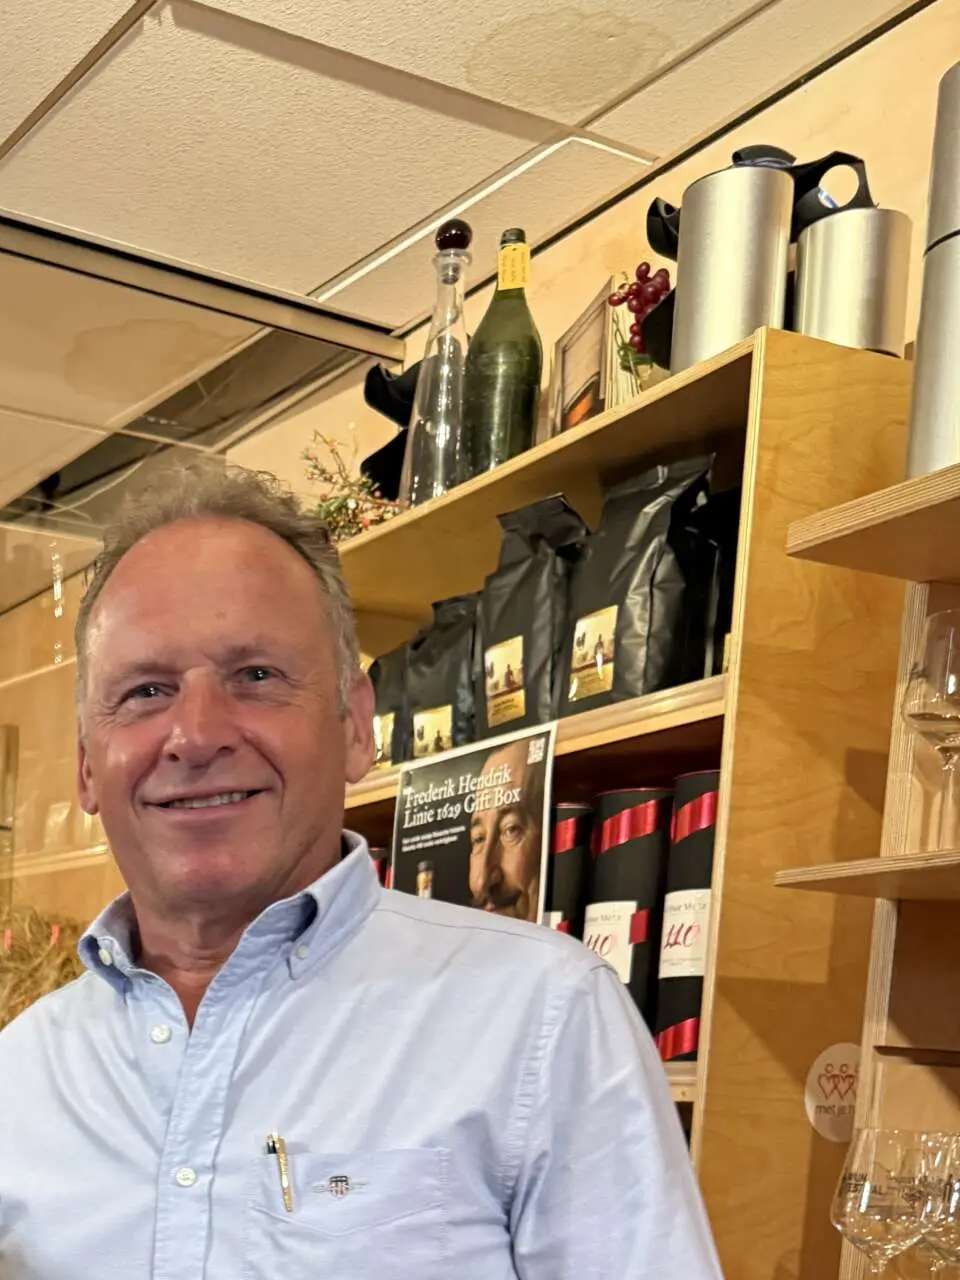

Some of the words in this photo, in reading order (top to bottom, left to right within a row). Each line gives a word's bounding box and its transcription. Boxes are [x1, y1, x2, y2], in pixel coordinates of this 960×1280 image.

[403, 778, 455, 808] Frederik
[458, 764, 512, 795] Hendrik
[403, 807, 437, 829] Linie
[437, 803, 461, 820] 1629
[464, 790, 493, 814] Gift
[494, 787, 522, 809] Box
